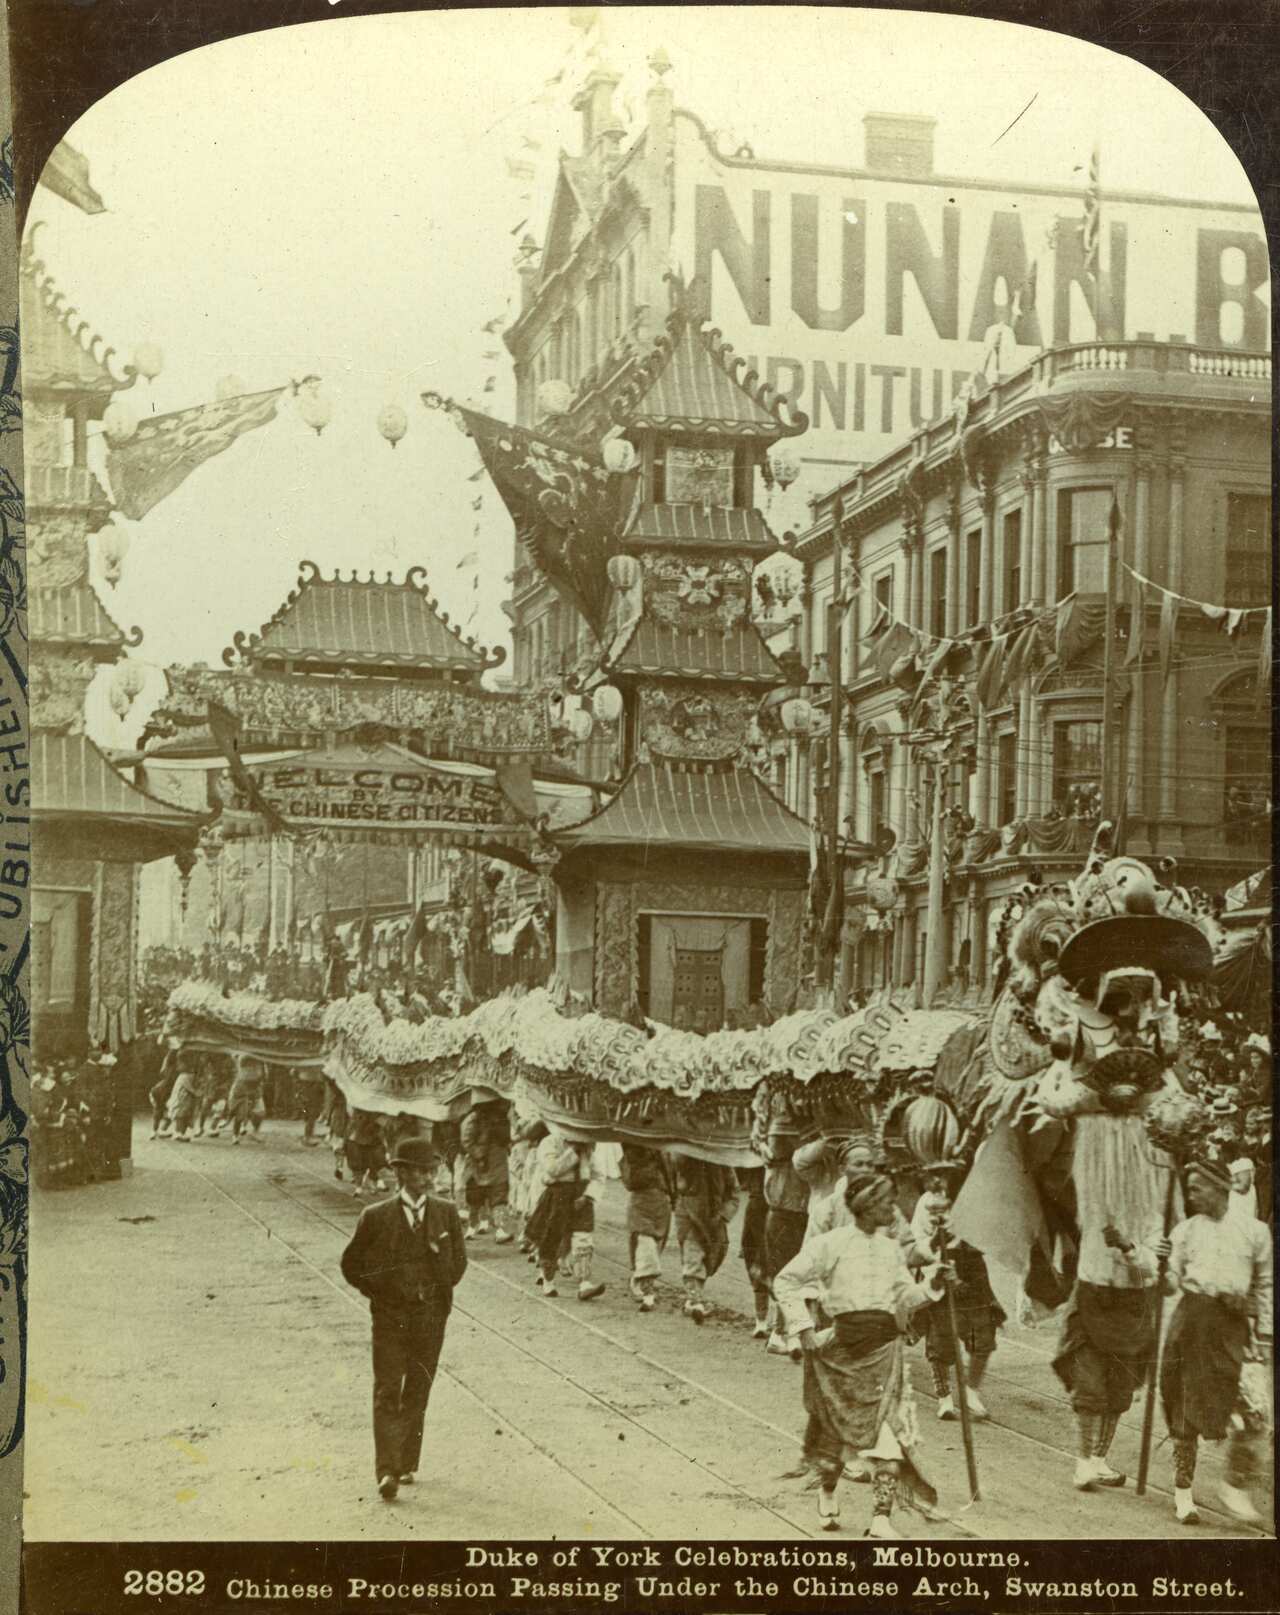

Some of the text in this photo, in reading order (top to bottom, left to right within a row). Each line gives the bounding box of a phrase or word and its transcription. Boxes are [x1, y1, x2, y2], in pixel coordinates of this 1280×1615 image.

[694, 184, 1128, 348] NUNAN
[353, 788, 380, 801] BY
[289, 800, 392, 820] CHINESE
